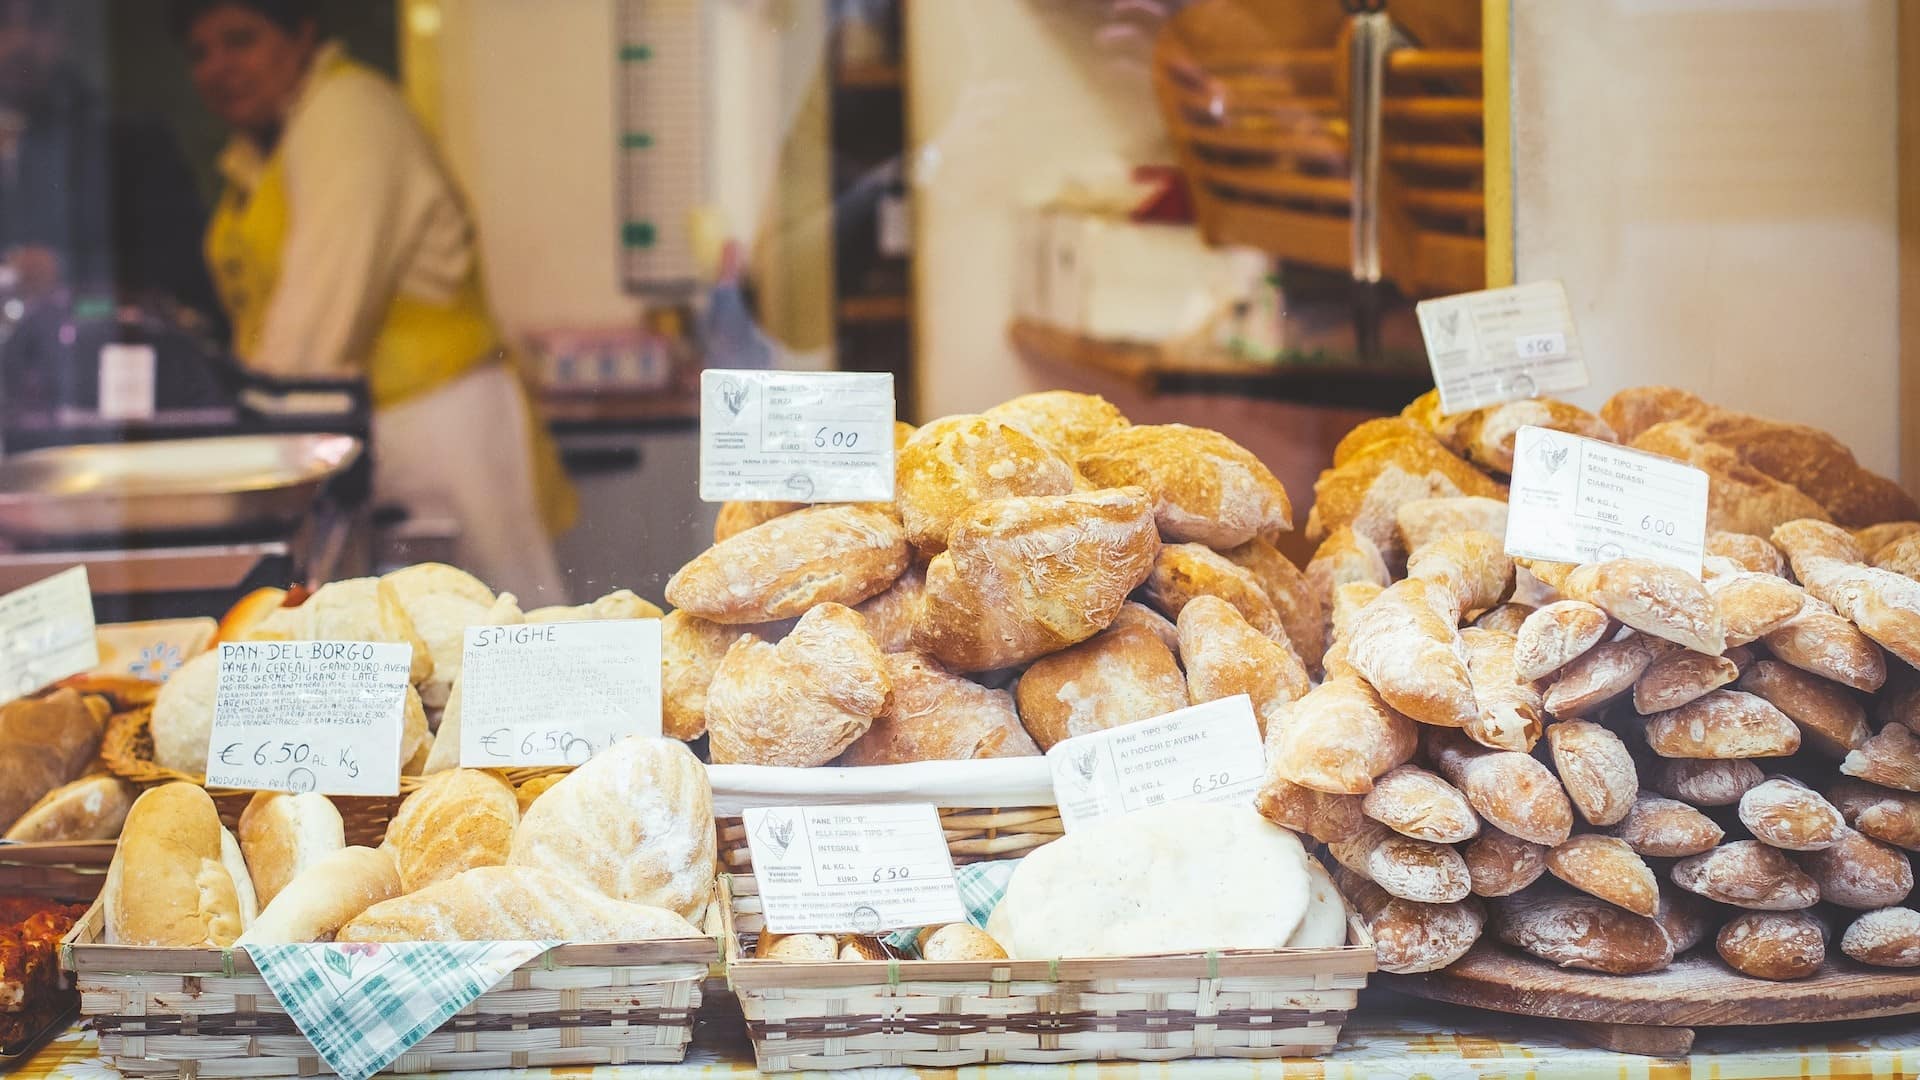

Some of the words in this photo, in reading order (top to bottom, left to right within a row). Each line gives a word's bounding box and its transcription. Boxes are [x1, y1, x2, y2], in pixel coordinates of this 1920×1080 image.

[1613, 458, 1632, 469] TIPO
[472, 626, 557, 647] SPIGHE
[222, 661, 249, 674] PANE
[265, 661, 312, 674] CEREALI
[222, 674, 248, 683] ORZO
[1116, 733, 1137, 745] PANE
[1142, 727, 1161, 738] TIPO
[1130, 742, 1164, 756] FIOCCHI
[1165, 732, 1200, 748] D'AVENA
[1201, 729, 1208, 739] E
[253, 740, 310, 766] 6.50
[312, 754, 329, 767] AL
[339, 745, 360, 778] Kg
[811, 817, 832, 825] PANE
[833, 815, 852, 824] TIPO
[818, 844, 860, 853] INTEGRALE
[822, 863, 833, 871] AL
[837, 875, 859, 883] EURO
